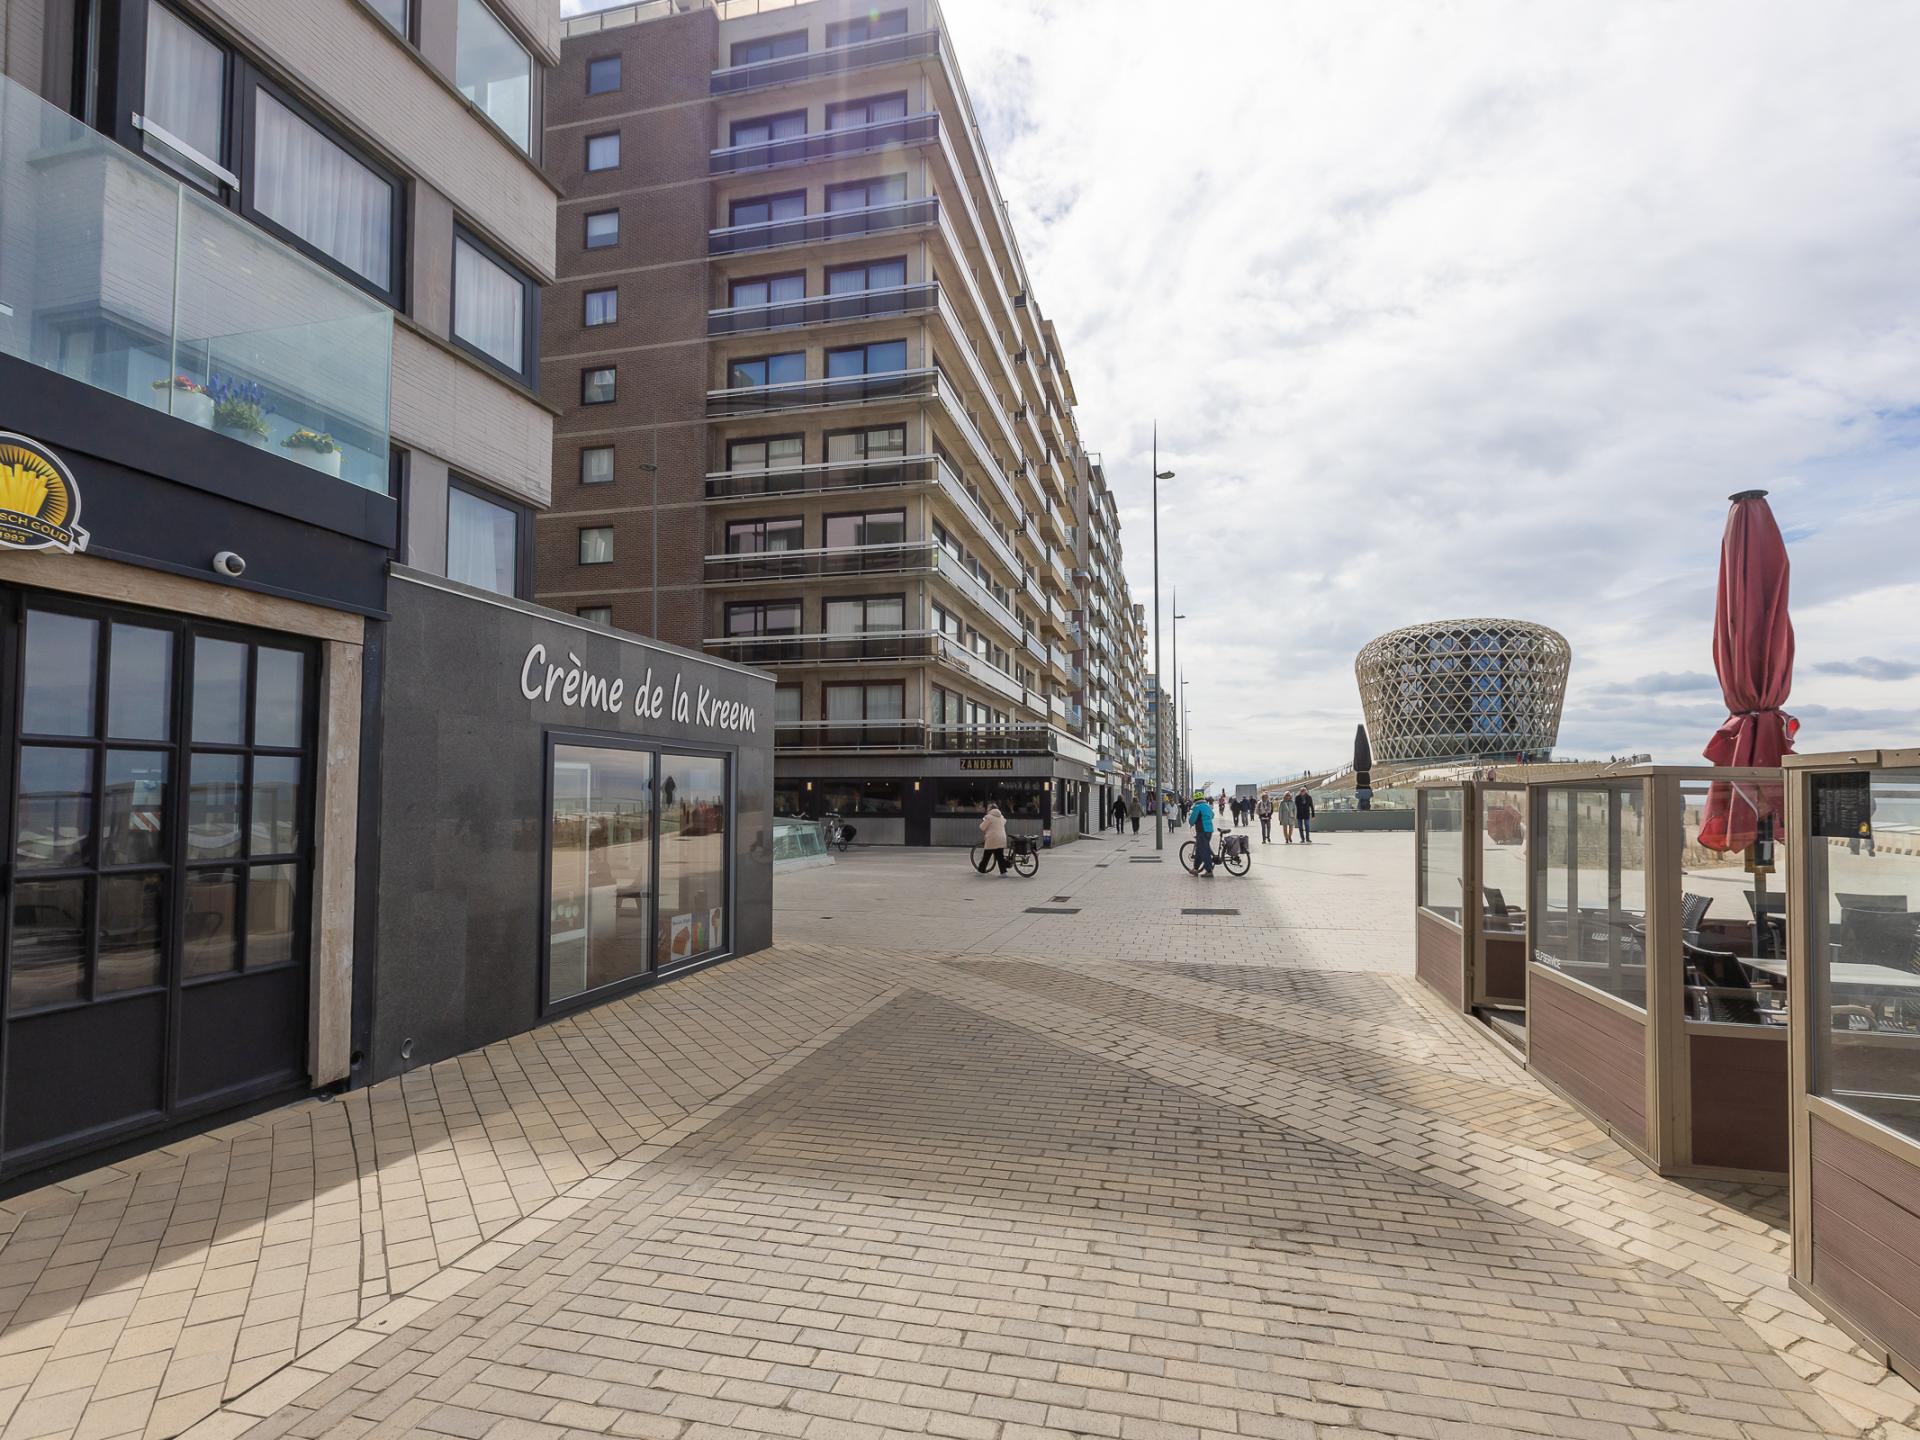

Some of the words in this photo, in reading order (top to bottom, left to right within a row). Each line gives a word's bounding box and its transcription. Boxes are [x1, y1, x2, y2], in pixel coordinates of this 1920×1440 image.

[31, 520, 69, 542] GOUD
[521, 643, 624, 713] Crème
[634, 667, 664, 719] de
[671, 672, 689, 724] la
[696, 684, 756, 734] Kreem
[961, 759, 1012, 769] ZANDBANK
[1534, 948, 1561, 970] ELFSERVICE
